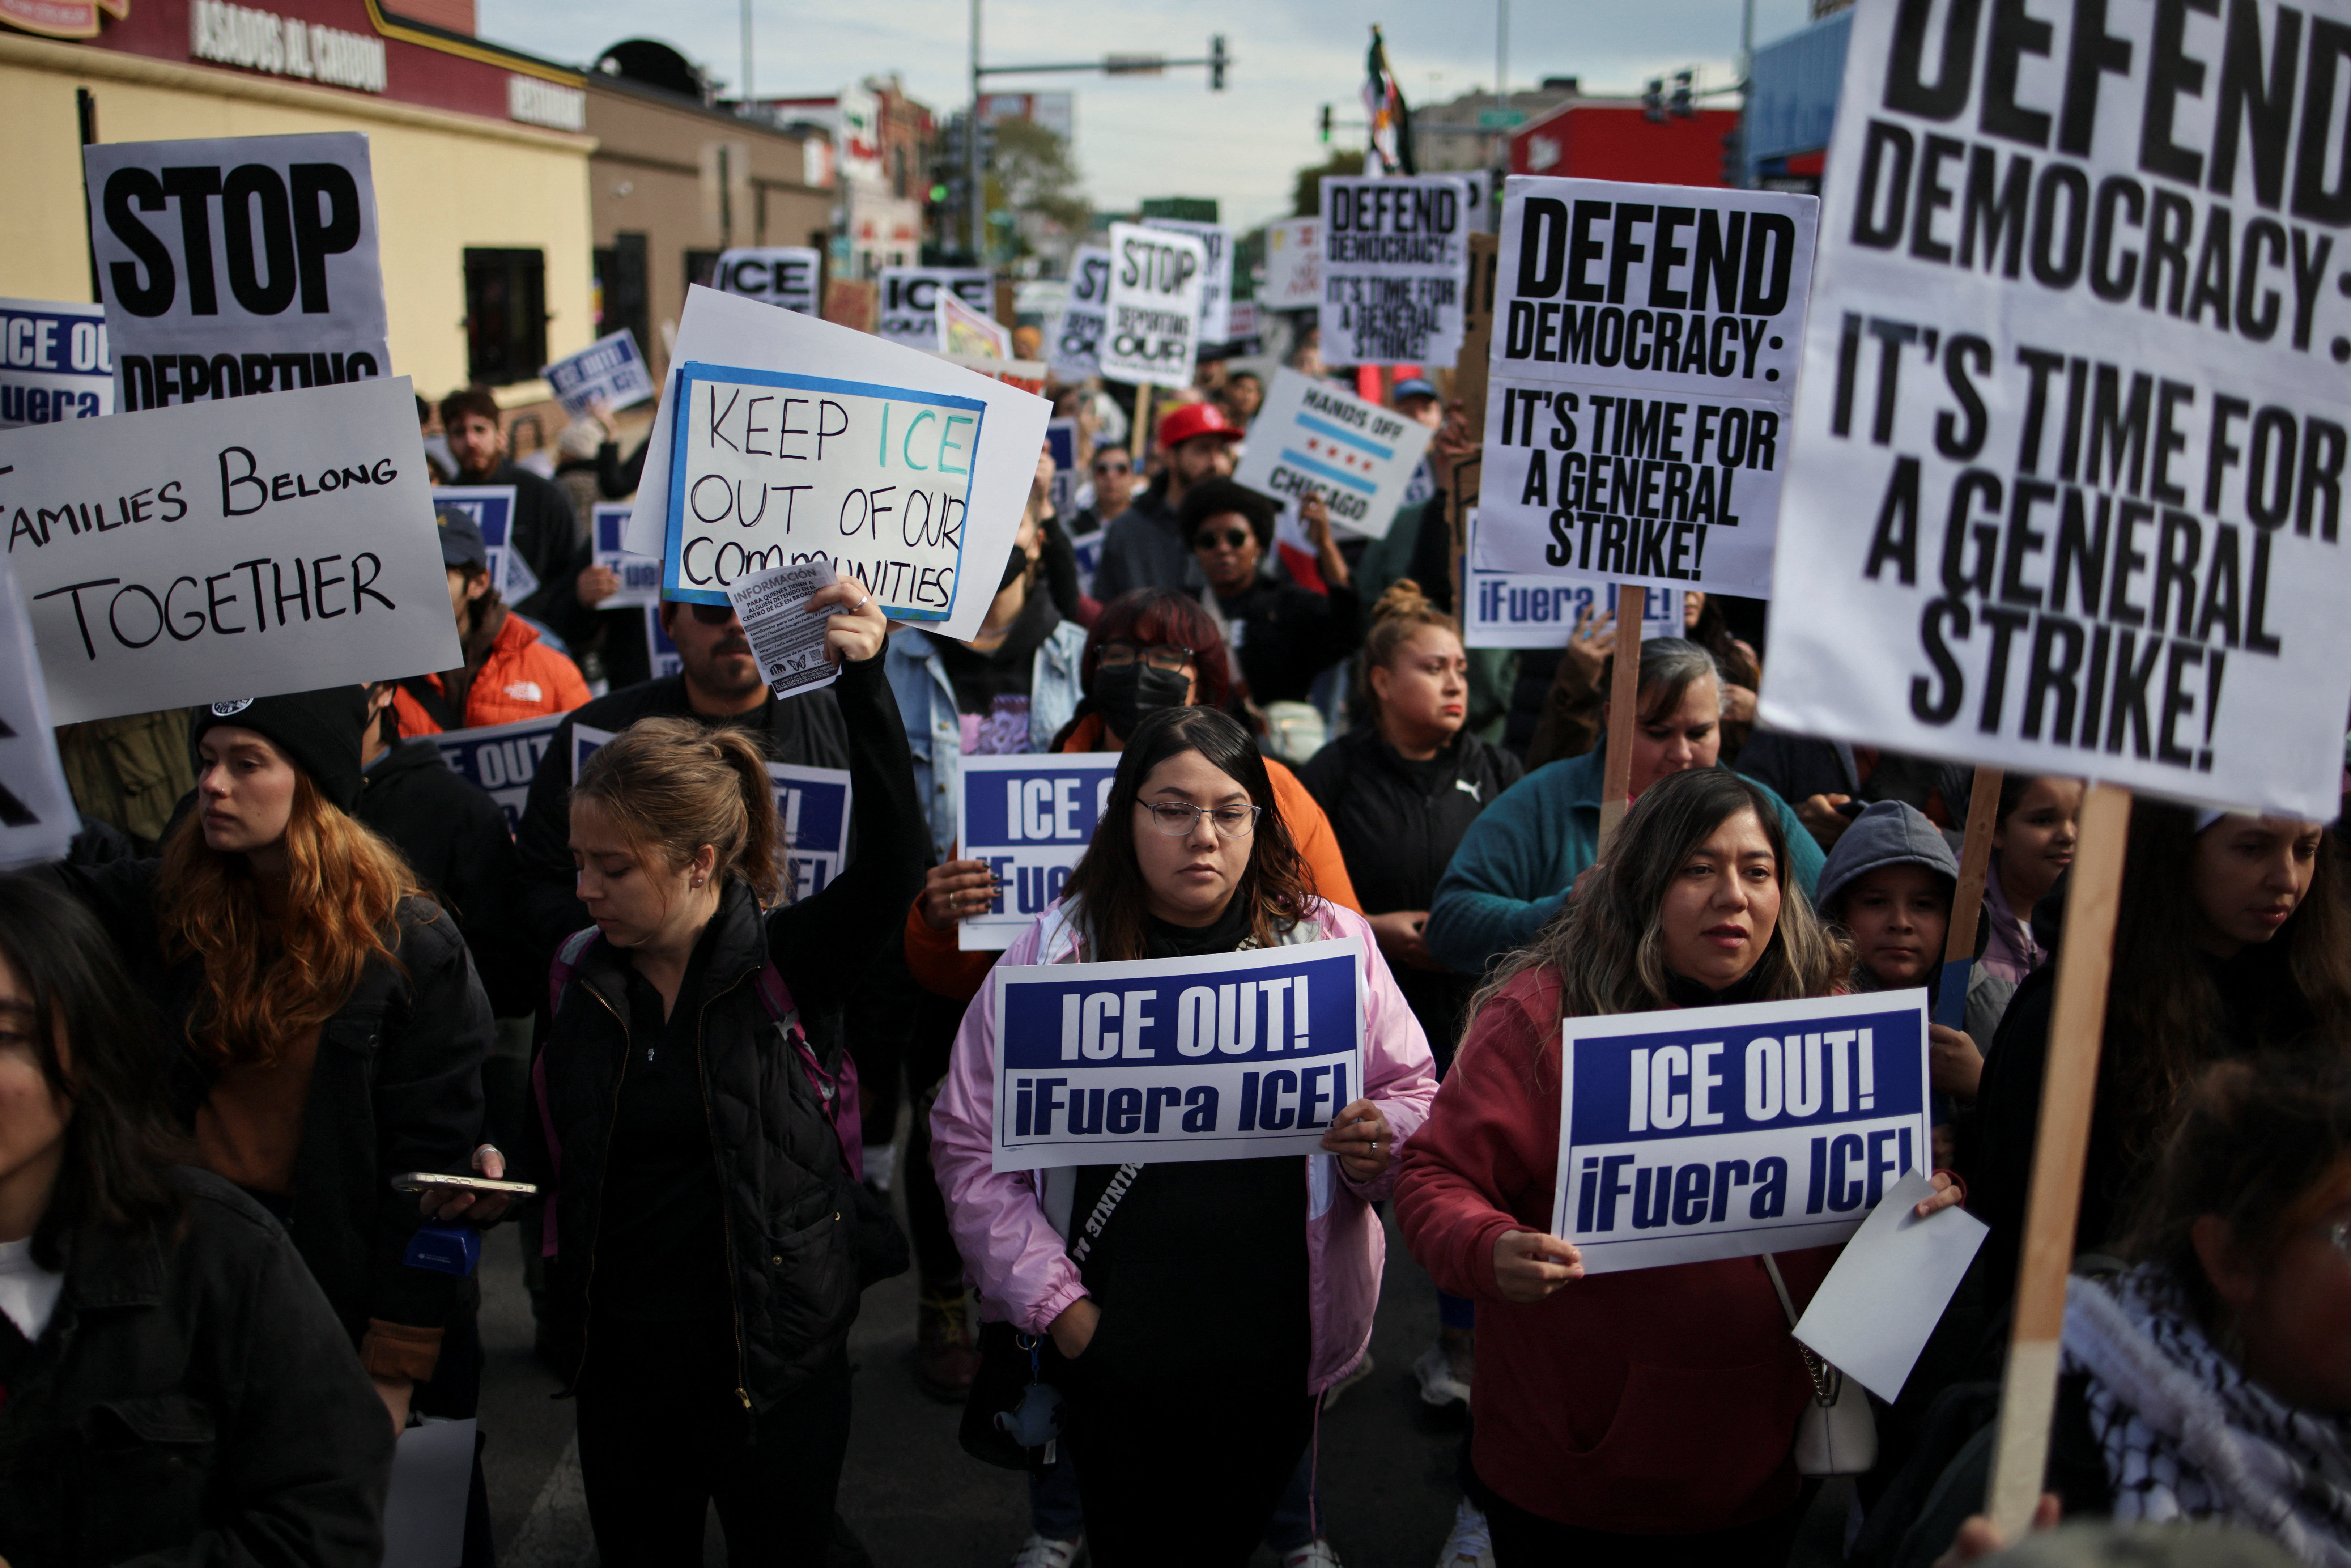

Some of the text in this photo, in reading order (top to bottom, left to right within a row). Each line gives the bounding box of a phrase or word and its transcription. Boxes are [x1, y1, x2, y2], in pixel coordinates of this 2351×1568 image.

[1880, 0, 2351, 228] DEFEND
[1332, 186, 1457, 234] DEFEND
[103, 163, 361, 318] STOP
[1122, 237, 1197, 296] STOP
[1328, 235, 1458, 265] DEMOCRACY:
[1516, 196, 1796, 316] DEFEND
[1850, 118, 2351, 364] DEMOCRACY:
[888, 278, 987, 314] ICE
[1327, 277, 1454, 306] IT'S TIME FOR
[1340, 305, 1440, 333] A GENERAL
[1114, 333, 1187, 365] OUR
[1353, 330, 1425, 360] STRIKE!
[1505, 300, 1784, 382] DEMOCRACY:
[710, 385, 974, 475] KEEP ICE
[1302, 387, 1404, 441] HANDS OFF
[1501, 387, 1778, 471] IT'S TIME FOR
[1831, 311, 2347, 543] IT'S TIME FOR
[690, 474, 813, 535] OUT
[840, 485, 896, 540] OF
[903, 489, 965, 551] OUR
[1269, 466, 1368, 521] CHICAGO
[1521, 450, 1548, 506] A
[1557, 451, 1739, 527] GENERAL
[1546, 510, 1708, 582] STRIKE!
[1863, 456, 2281, 656] A GENERAL
[33, 552, 396, 661] TOGETHER
[734, 567, 817, 603] INFORMACIÓN
[747, 598, 762, 607] PARA
[764, 587, 787, 601] QUIENES
[788, 582, 807, 590] TIENEN
[749, 599, 773, 613] ALGUIEN
[774, 588, 800, 602] DETENIDO
[1478, 580, 1670, 622] ¡Fuera IE!
[743, 609, 765, 622] CENTRO
[750, 624, 776, 637] Localizador
[776, 653, 791, 661] directa
[786, 676, 802, 685] ALIANZA
[807, 669, 824, 679] CHICAGO
[797, 676, 813, 685] RACISTA
[800, 667, 819, 677] DERECHOS
[1910, 595, 2227, 773] STRIKE!
[1008, 777, 1081, 841] ICE
[1061, 975, 1309, 1061] ICE OUT!
[1015, 1062, 1348, 1136] ¡Fuera ICE!
[1629, 1028, 1874, 1133] ICE OUT!
[1576, 1154, 1787, 1233] ¡Fuera
